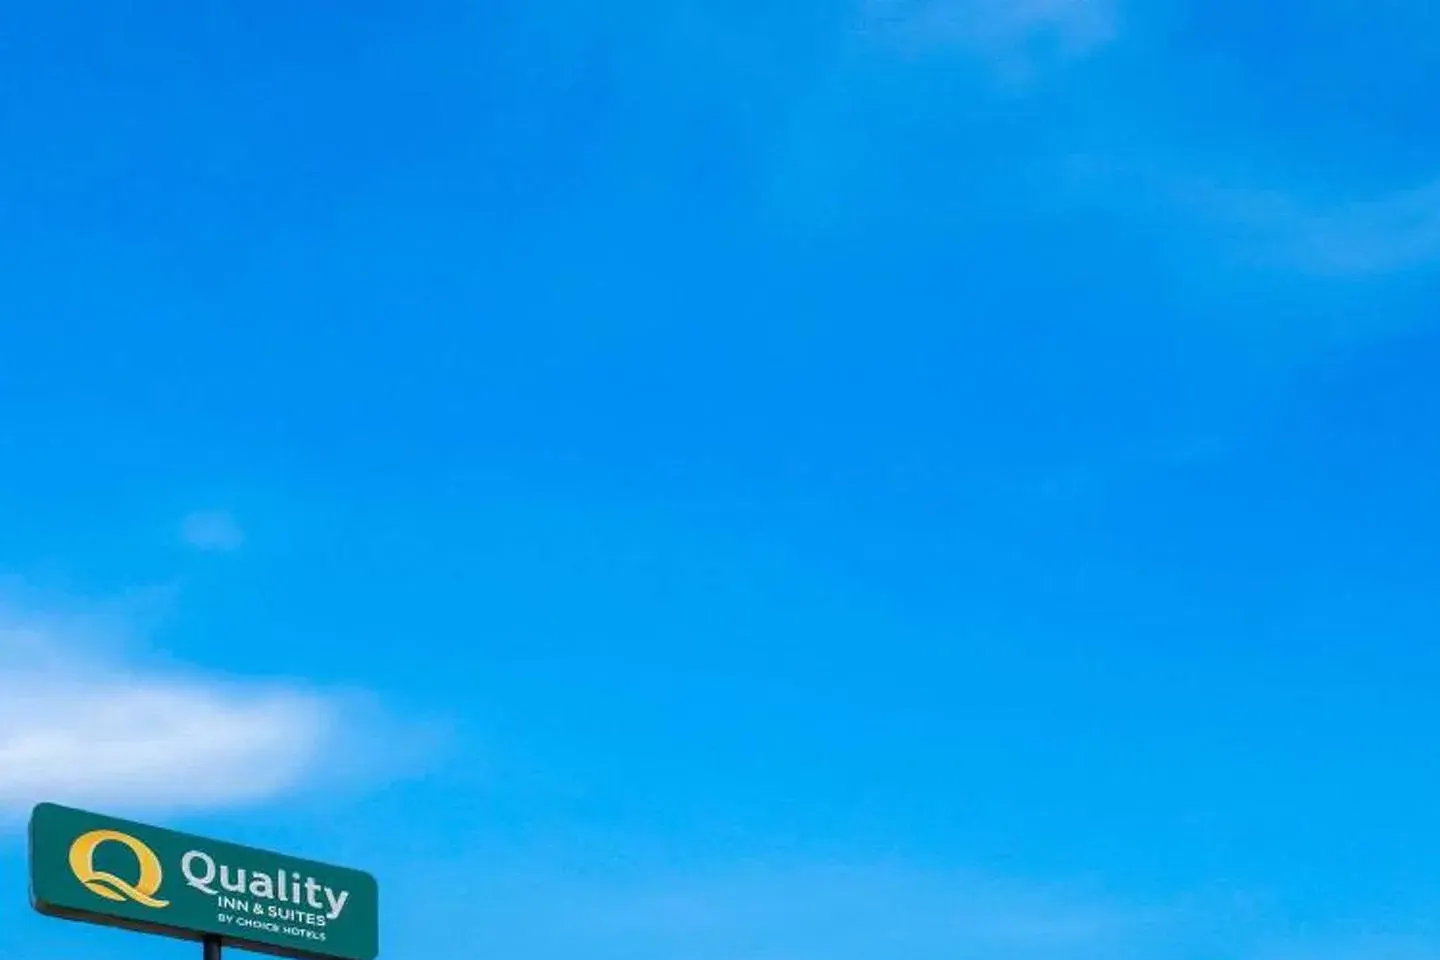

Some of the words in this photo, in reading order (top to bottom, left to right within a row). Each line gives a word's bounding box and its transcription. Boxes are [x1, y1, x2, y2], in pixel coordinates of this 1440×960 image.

[181, 849, 349, 919] Quality
[217, 895, 249, 912] INN
[252, 902, 264, 915] &
[268, 905, 326, 926] SUITES
[217, 913, 233, 924] BY
[235, 917, 280, 933] CHOICE
[282, 926, 327, 941] HOTELS
